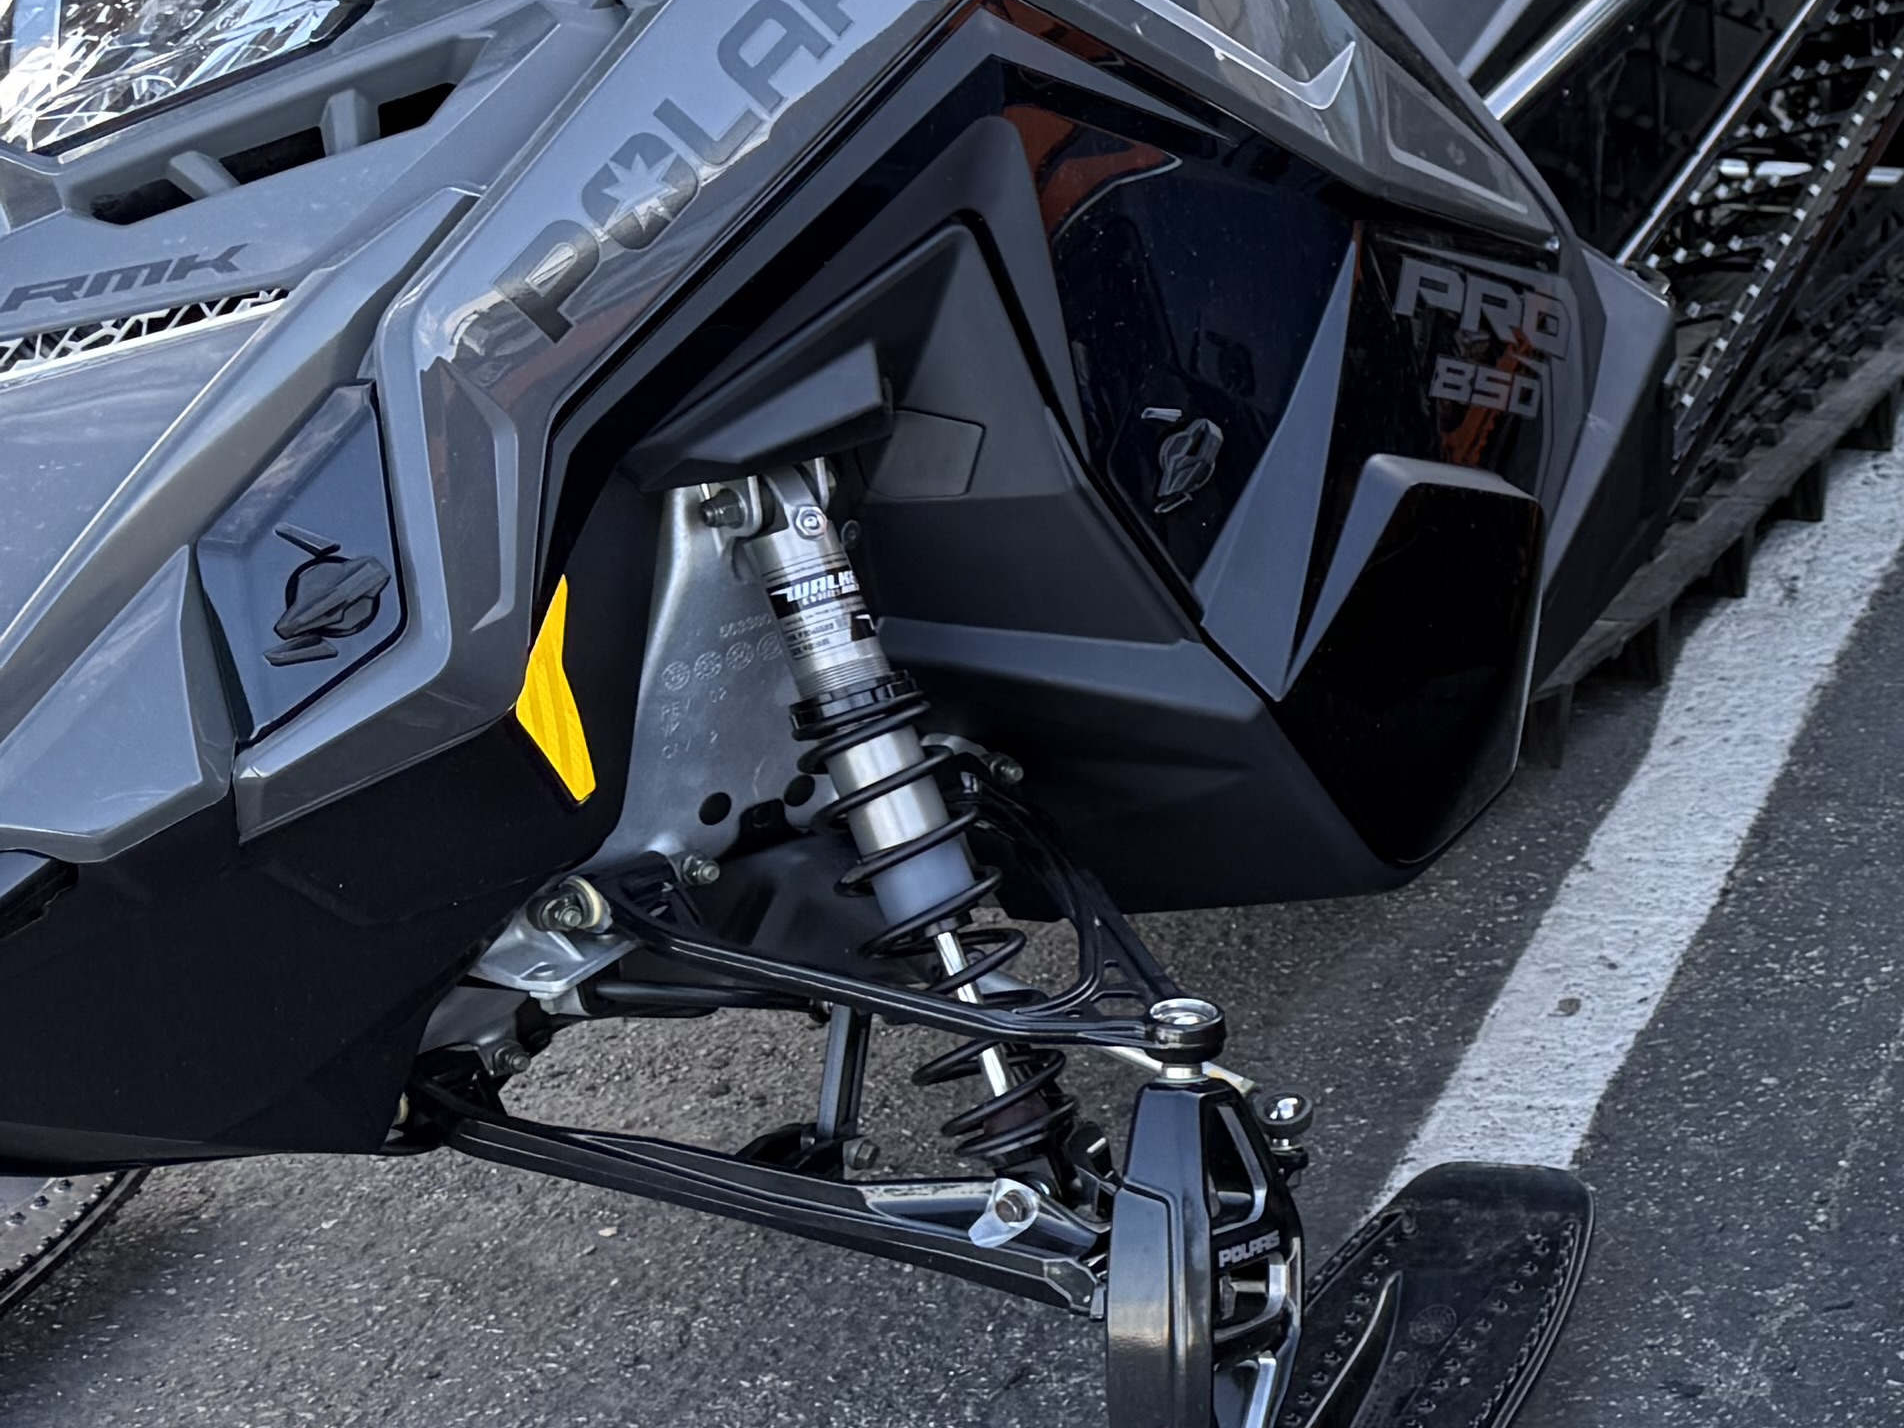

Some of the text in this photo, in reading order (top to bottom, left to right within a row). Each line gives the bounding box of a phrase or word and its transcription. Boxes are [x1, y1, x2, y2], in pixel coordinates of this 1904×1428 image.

[0, 243, 249, 313] RMK
[1392, 256, 1572, 361] PRO
[1429, 356, 1542, 418] 850
